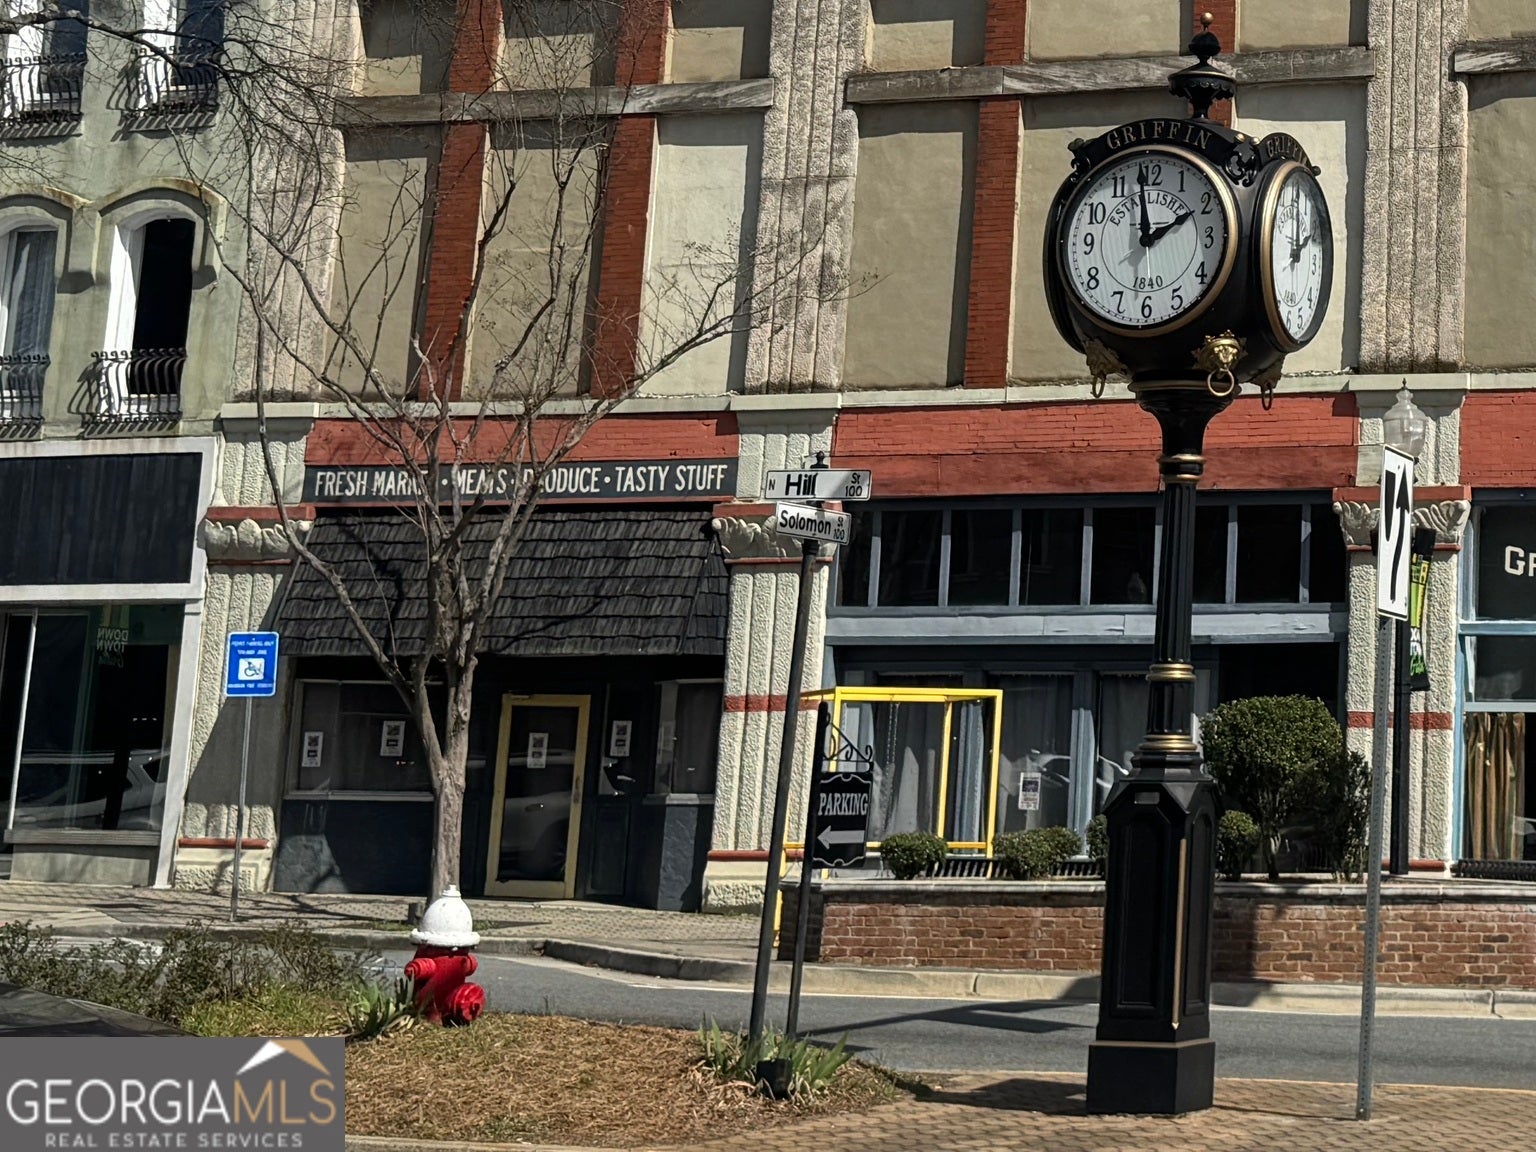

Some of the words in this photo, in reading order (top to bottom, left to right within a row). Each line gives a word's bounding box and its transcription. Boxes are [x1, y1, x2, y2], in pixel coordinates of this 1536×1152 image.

[1106, 120, 1212, 150] GRIFFIN
[1111, 175, 1126, 198] 11
[1143, 164, 1163, 186] 12
[1178, 170, 1186, 192] 1
[1088, 202, 1106, 225] 10
[1110, 192, 1189, 226] ESTALISHE
[1201, 192, 1213, 215] 2
[1084, 233, 1095, 255] 9
[1204, 226, 1214, 248] 3
[1087, 266, 1100, 290] 8
[1133, 275, 1163, 290] 1840
[1195, 261, 1208, 285] 4
[1110, 291, 1126, 315] 7
[1141, 296, 1152, 319] 6
[1170, 285, 1183, 310] 5
[315, 471, 368, 496] FRESH
[371, 470, 430, 496] MARK
[522, 467, 602, 494] PODUCE
[615, 465, 671, 493] TASTY
[674, 464, 728, 491] STUFF
[768, 479, 776, 491] N
[785, 473, 818, 496] Hill
[851, 472, 861, 484] St
[845, 485, 863, 497] 100
[779, 510, 831, 535] Solomon
[837, 516, 844, 527] St
[817, 792, 869, 816] PARKING
